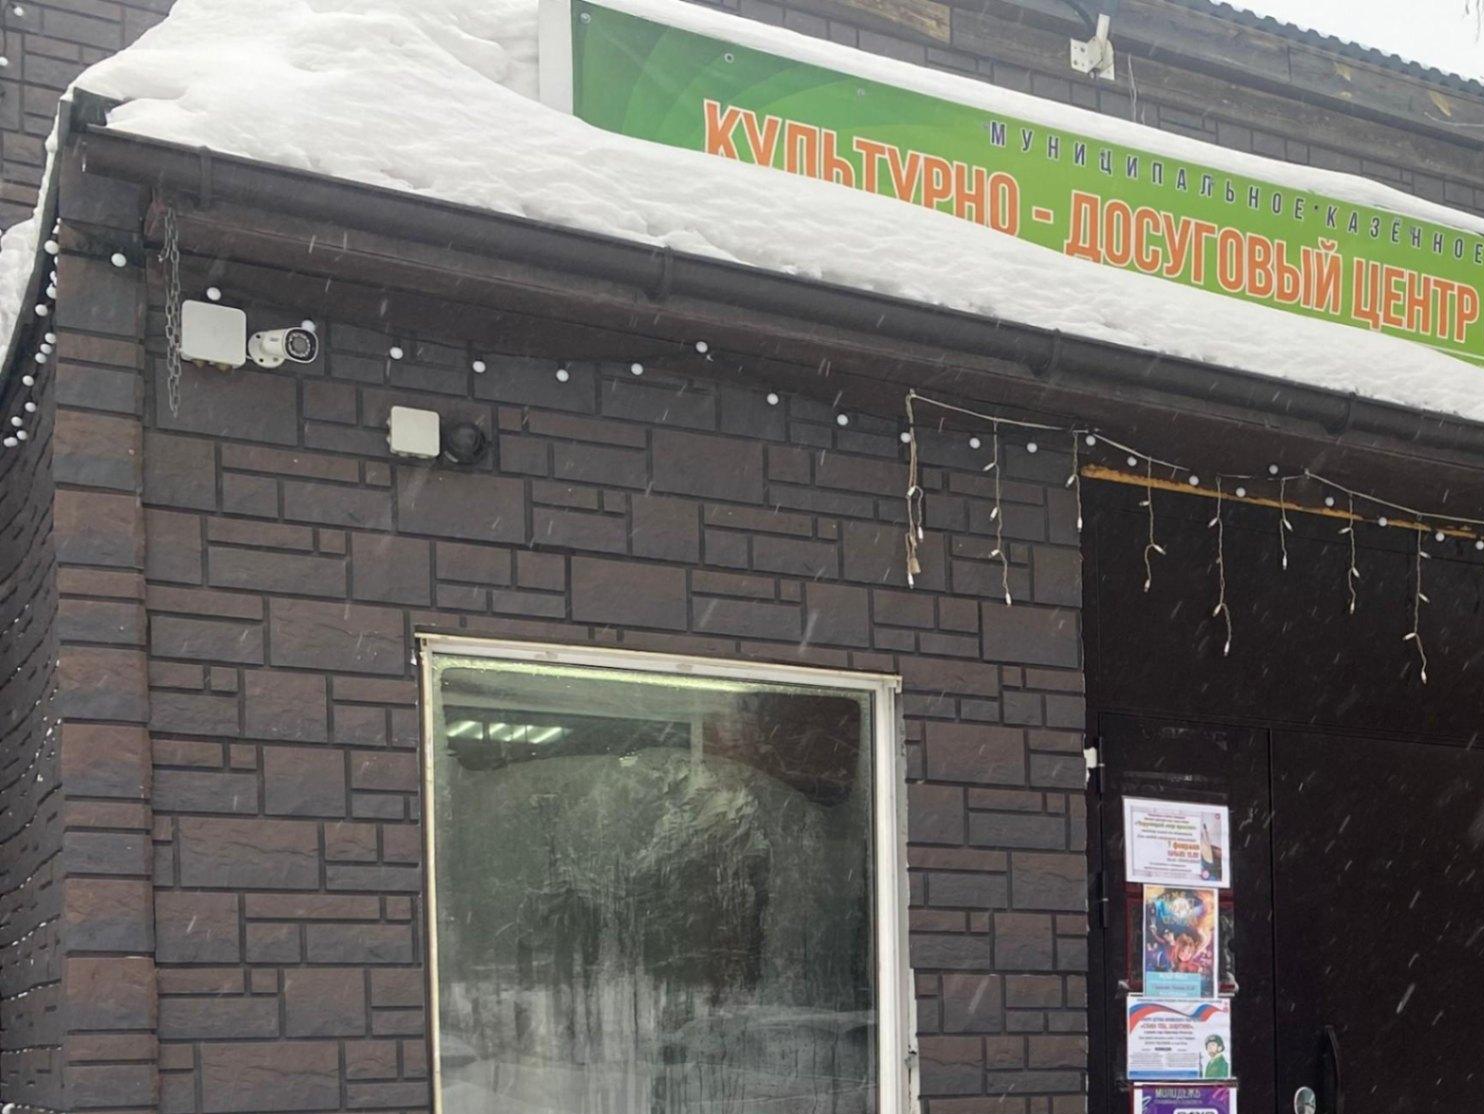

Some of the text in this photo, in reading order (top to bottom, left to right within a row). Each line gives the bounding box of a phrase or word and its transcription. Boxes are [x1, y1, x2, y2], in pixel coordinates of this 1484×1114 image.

[703, 98, 1020, 237] КУЛЬТУРНО
[1064, 189, 1342, 315] ДОСУГОВЫЙ
[1351, 256, 1479, 344] ЦЕНТР
[990, 121, 1305, 221] МУНИЦИПАЛЬНОЕ
